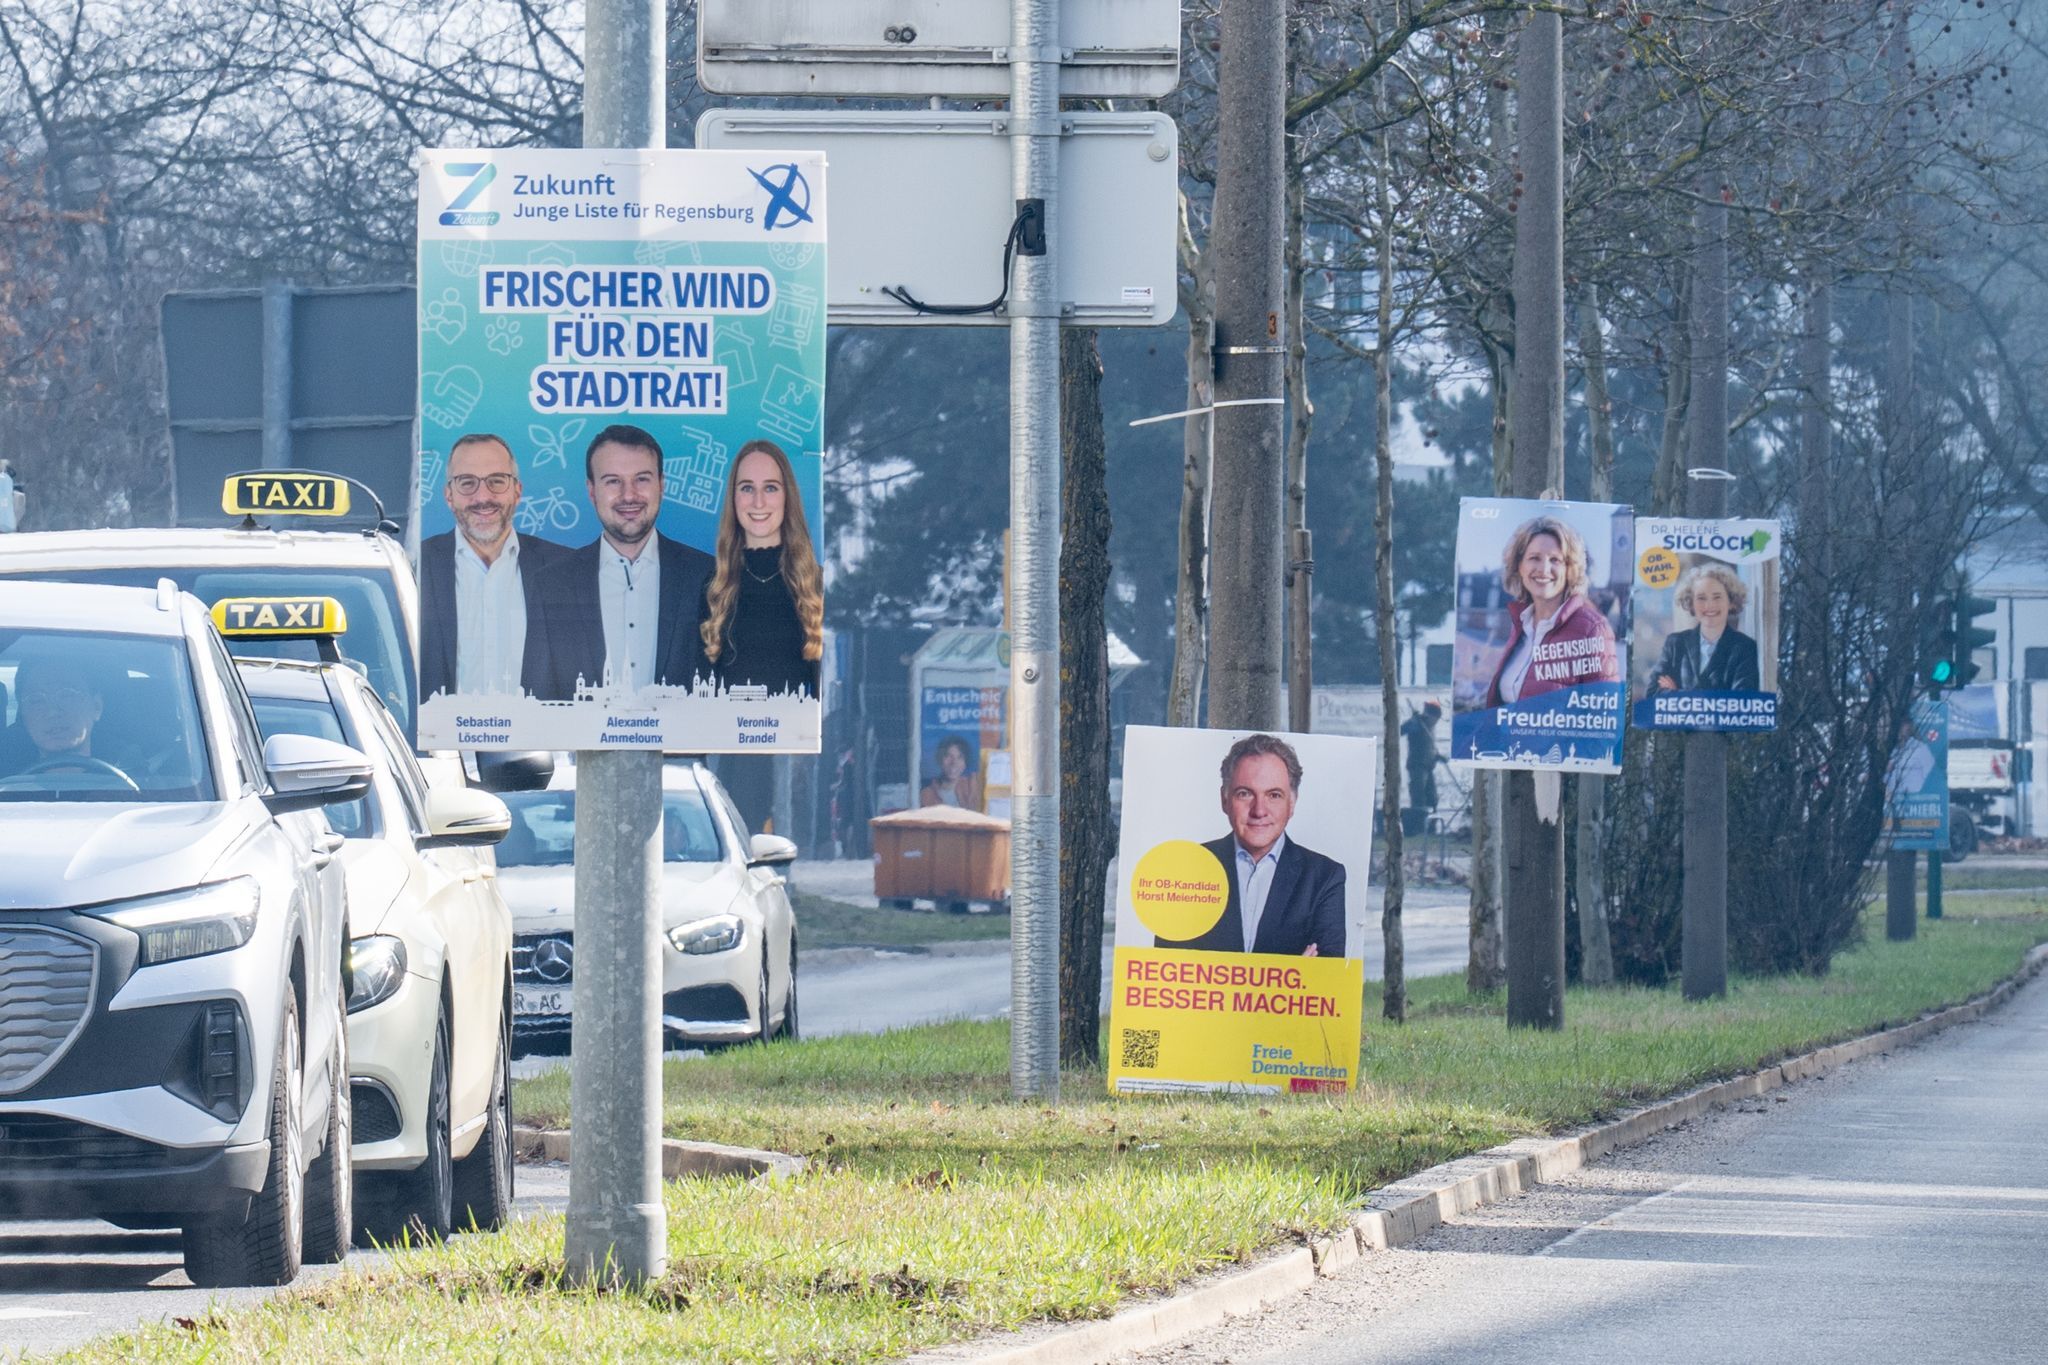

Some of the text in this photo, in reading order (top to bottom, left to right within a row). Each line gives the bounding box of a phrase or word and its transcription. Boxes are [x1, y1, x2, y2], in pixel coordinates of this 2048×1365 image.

[513, 174, 615, 196] Zukunft
[453, 213, 497, 225] Zukunft
[513, 203, 754, 224] Junge Liste für Regensburg
[485, 270, 771, 309] FRISCHER WIND
[1269, 314, 1277, 336] 3
[554, 312, 708, 358] FÜR DEN
[536, 370, 722, 408] STADTRAT!
[246, 481, 326, 507] TAXI
[1471, 508, 1500, 518] CSU
[1651, 525, 1720, 535] DR. HELENE
[1663, 535, 1754, 551] SIGLOCH
[1647, 554, 1667, 563] OB-
[1642, 563, 1674, 574] WAHL
[230, 604, 320, 627] TAXI
[1533, 637, 1605, 662] REGENSBURG
[1535, 657, 1602, 681] KANN MEHR
[1567, 691, 1618, 710] Astrid
[1655, 697, 1775, 713] REGENSBURG
[456, 715, 512, 728] Sebastian
[607, 716, 660, 728] Alexander
[737, 716, 779, 729] Veronika
[1497, 708, 1616, 730] Freudenstein
[1654, 714, 1775, 727] EINFACH MACHEN
[458, 732, 510, 743] Löschner
[600, 732, 663, 744] Ammelounx
[738, 732, 776, 744] Brandel
[1139, 878, 1220, 892] Ihr OB-Kandidat
[1137, 891, 1221, 904] Horst Meierhofer
[1127, 960, 1306, 989] REGENSBURG.
[1125, 987, 1341, 1017] BESSER MACHEN.
[1252, 1044, 1292, 1060] Freie
[1252, 1060, 1347, 1078] Demokraten
